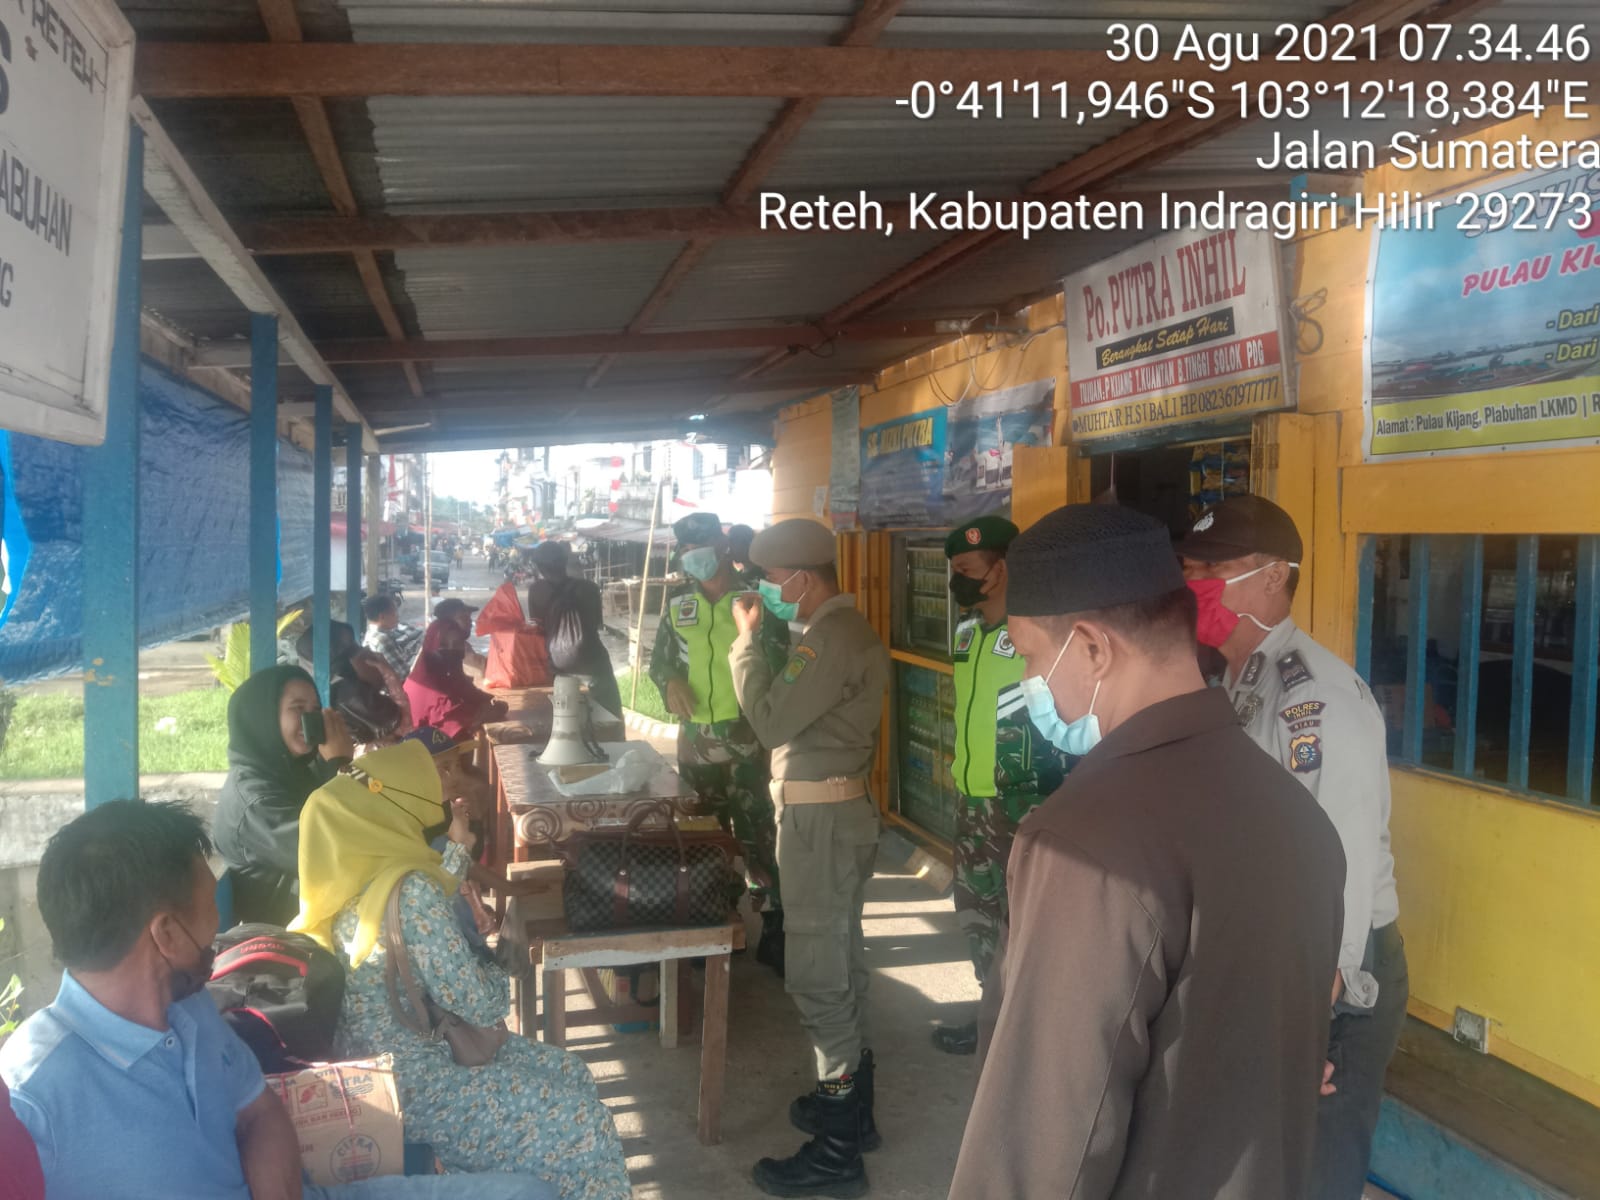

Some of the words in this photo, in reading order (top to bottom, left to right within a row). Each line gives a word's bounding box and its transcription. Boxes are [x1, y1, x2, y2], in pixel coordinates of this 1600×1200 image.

[1177, 229, 1246, 313] INHIL
[1462, 255, 1552, 297] PULAU
[1557, 305, 1600, 331] Dari
[1102, 335, 1153, 367] Berangkat
[1155, 325, 1194, 350] Setiap
[1197, 316, 1230, 337] Hari
[1214, 343, 1243, 375] SOLOK
[1246, 338, 1265, 369] PDG
[1556, 338, 1598, 363] Dari
[1079, 408, 1123, 433] MUHTAR
[1149, 397, 1177, 422] BALI
[1416, 413, 1444, 430] Pulau
[1446, 409, 1481, 430] Kijang,
[1485, 404, 1538, 424] Plabuhan
[1540, 396, 1577, 417] LKMD
[1284, 702, 1320, 718] POLRES
